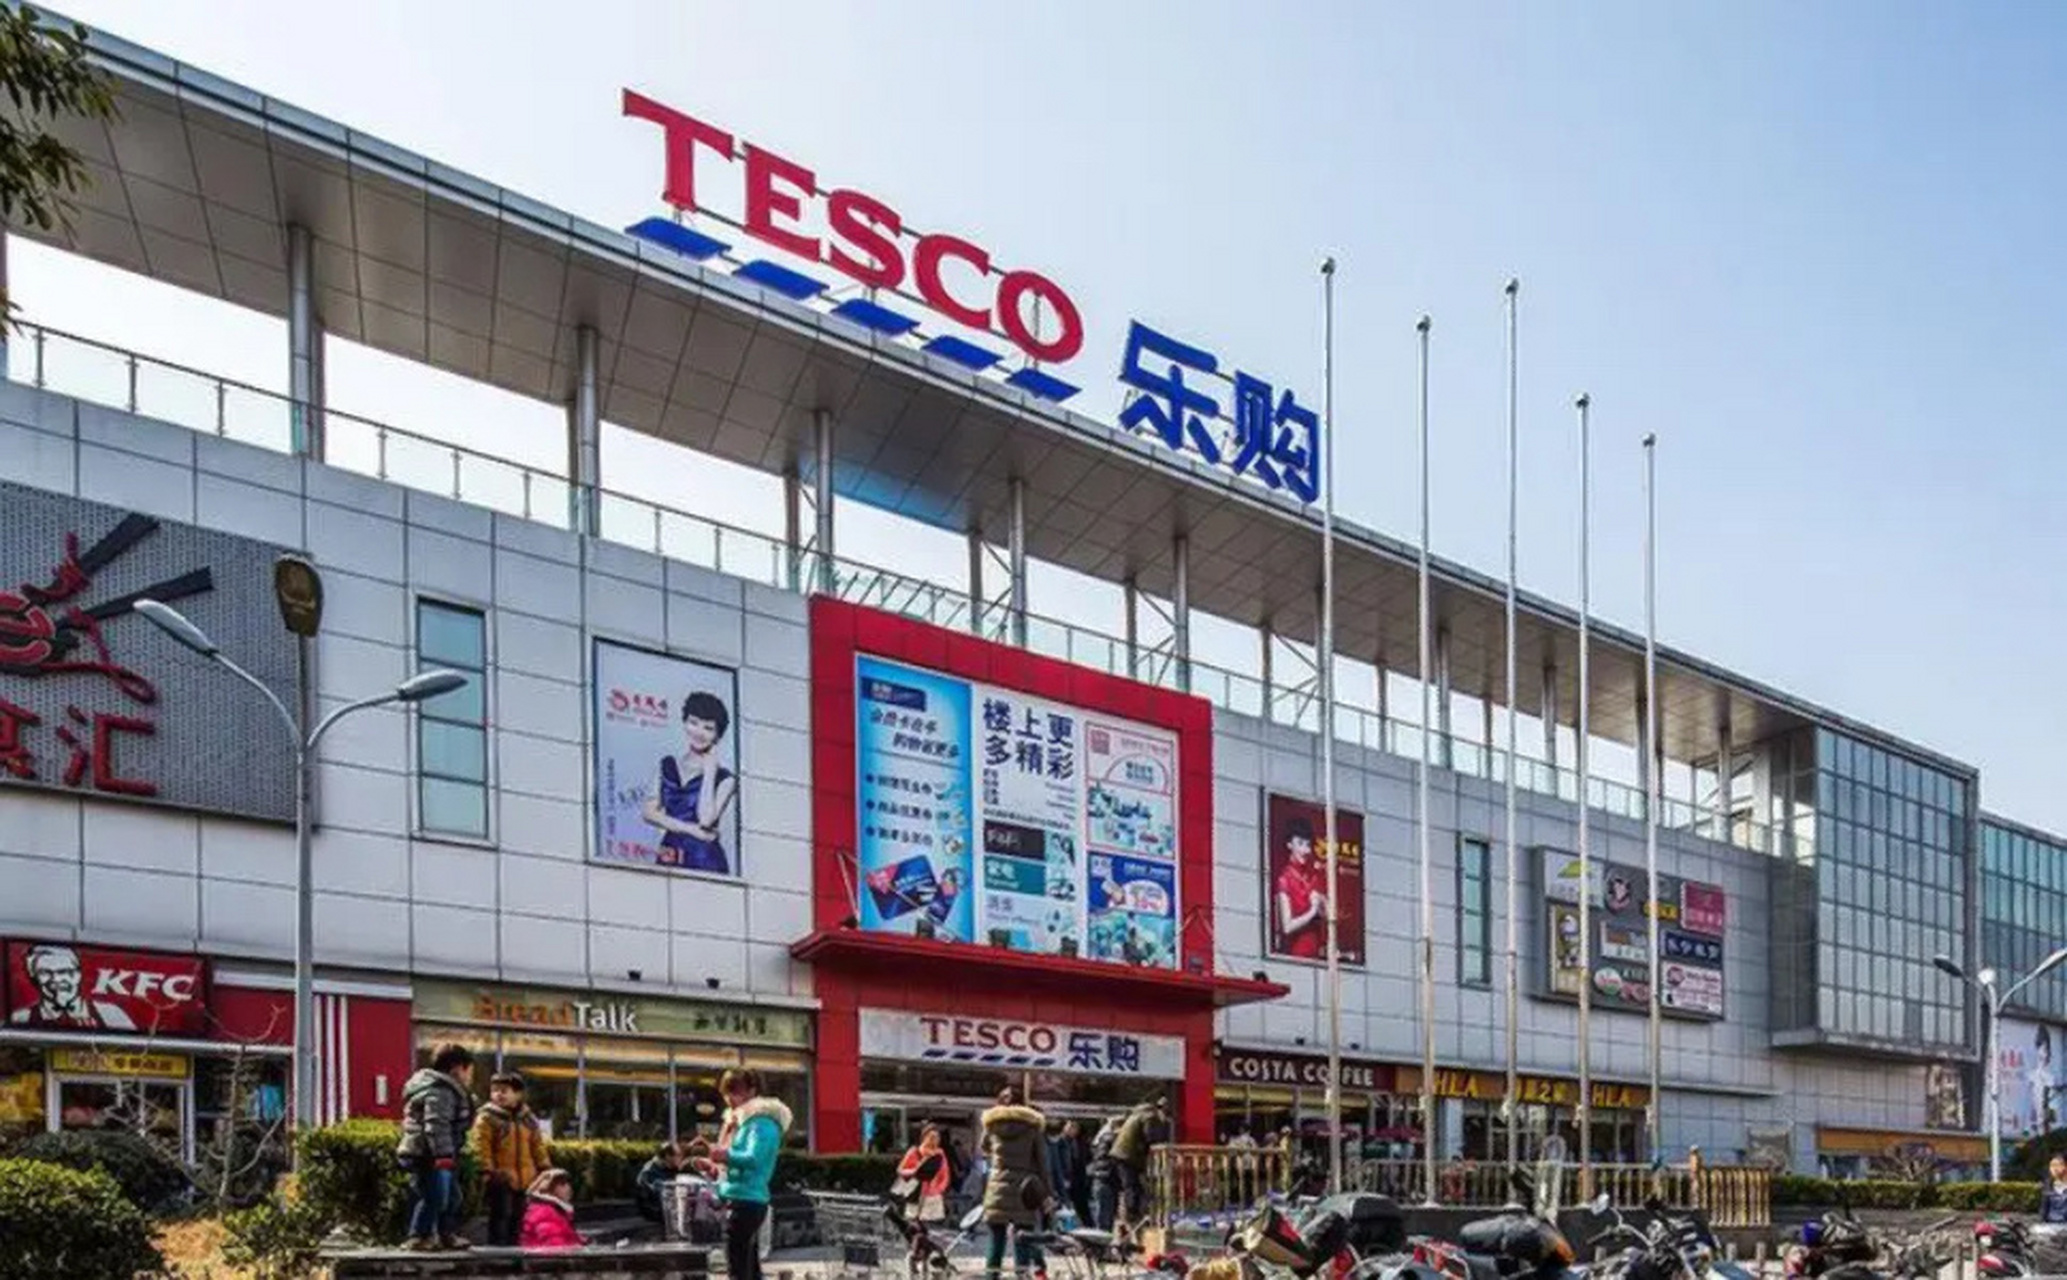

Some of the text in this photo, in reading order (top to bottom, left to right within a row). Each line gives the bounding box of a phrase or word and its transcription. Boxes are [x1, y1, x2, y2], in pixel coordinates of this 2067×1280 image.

[621, 87, 1085, 364] TESCO
[1117, 318, 1319, 503] 乐购
[983, 698, 1074, 750] 楼上更
[984, 735, 1074, 780] 多精彩
[91, 968, 196, 1001] KFC
[472, 996, 638, 1033] BreadTalk
[919, 1016, 1057, 1054] TESCO
[1067, 1031, 1140, 1072] 乐购
[1229, 1057, 1375, 1087] COSTA COFEE
[1432, 1071, 1478, 1098] HLA
[1592, 1083, 1633, 1108] HLA
